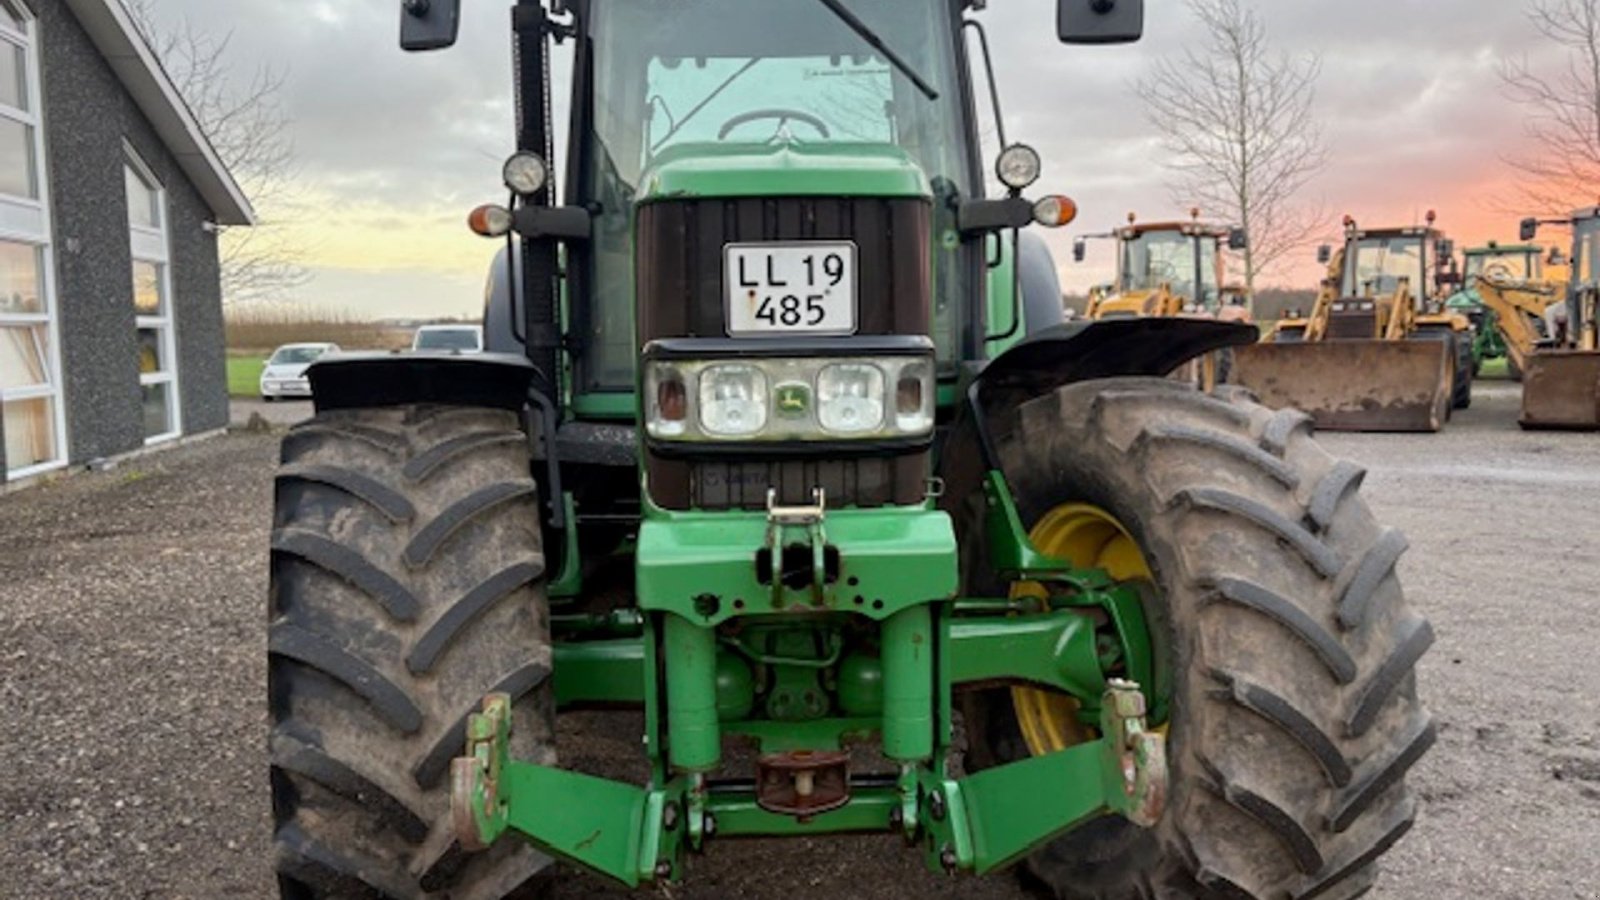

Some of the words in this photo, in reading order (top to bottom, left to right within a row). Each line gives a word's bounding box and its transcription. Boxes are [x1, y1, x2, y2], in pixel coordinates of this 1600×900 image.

[739, 254, 787, 287] LL
[802, 253, 844, 287] 19
[755, 294, 826, 326] 485
